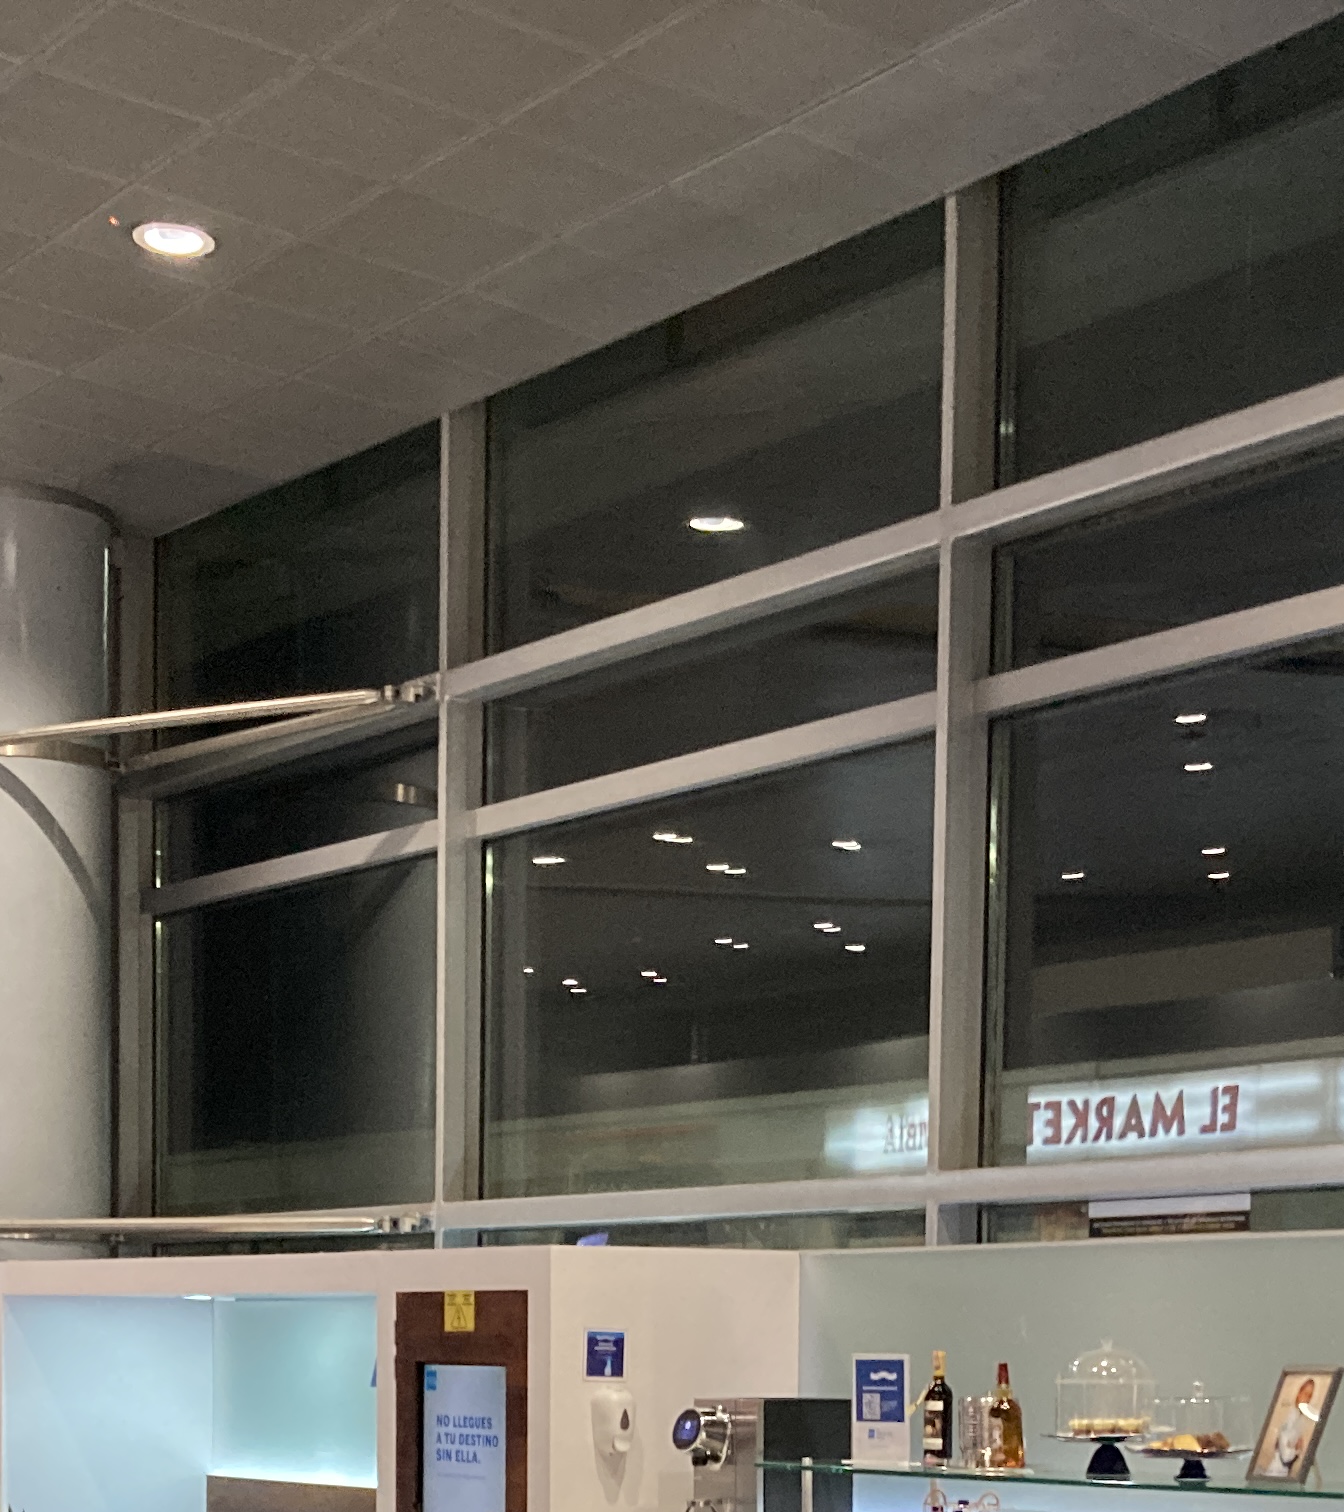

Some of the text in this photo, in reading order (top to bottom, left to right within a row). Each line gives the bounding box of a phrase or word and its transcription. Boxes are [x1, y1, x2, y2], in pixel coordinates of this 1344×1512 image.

[436, 1415, 492, 1429] NO LLEGUES
[436, 1432, 499, 1447] A TU DESTINO
[436, 1448, 481, 1464] SIN ELLA.
